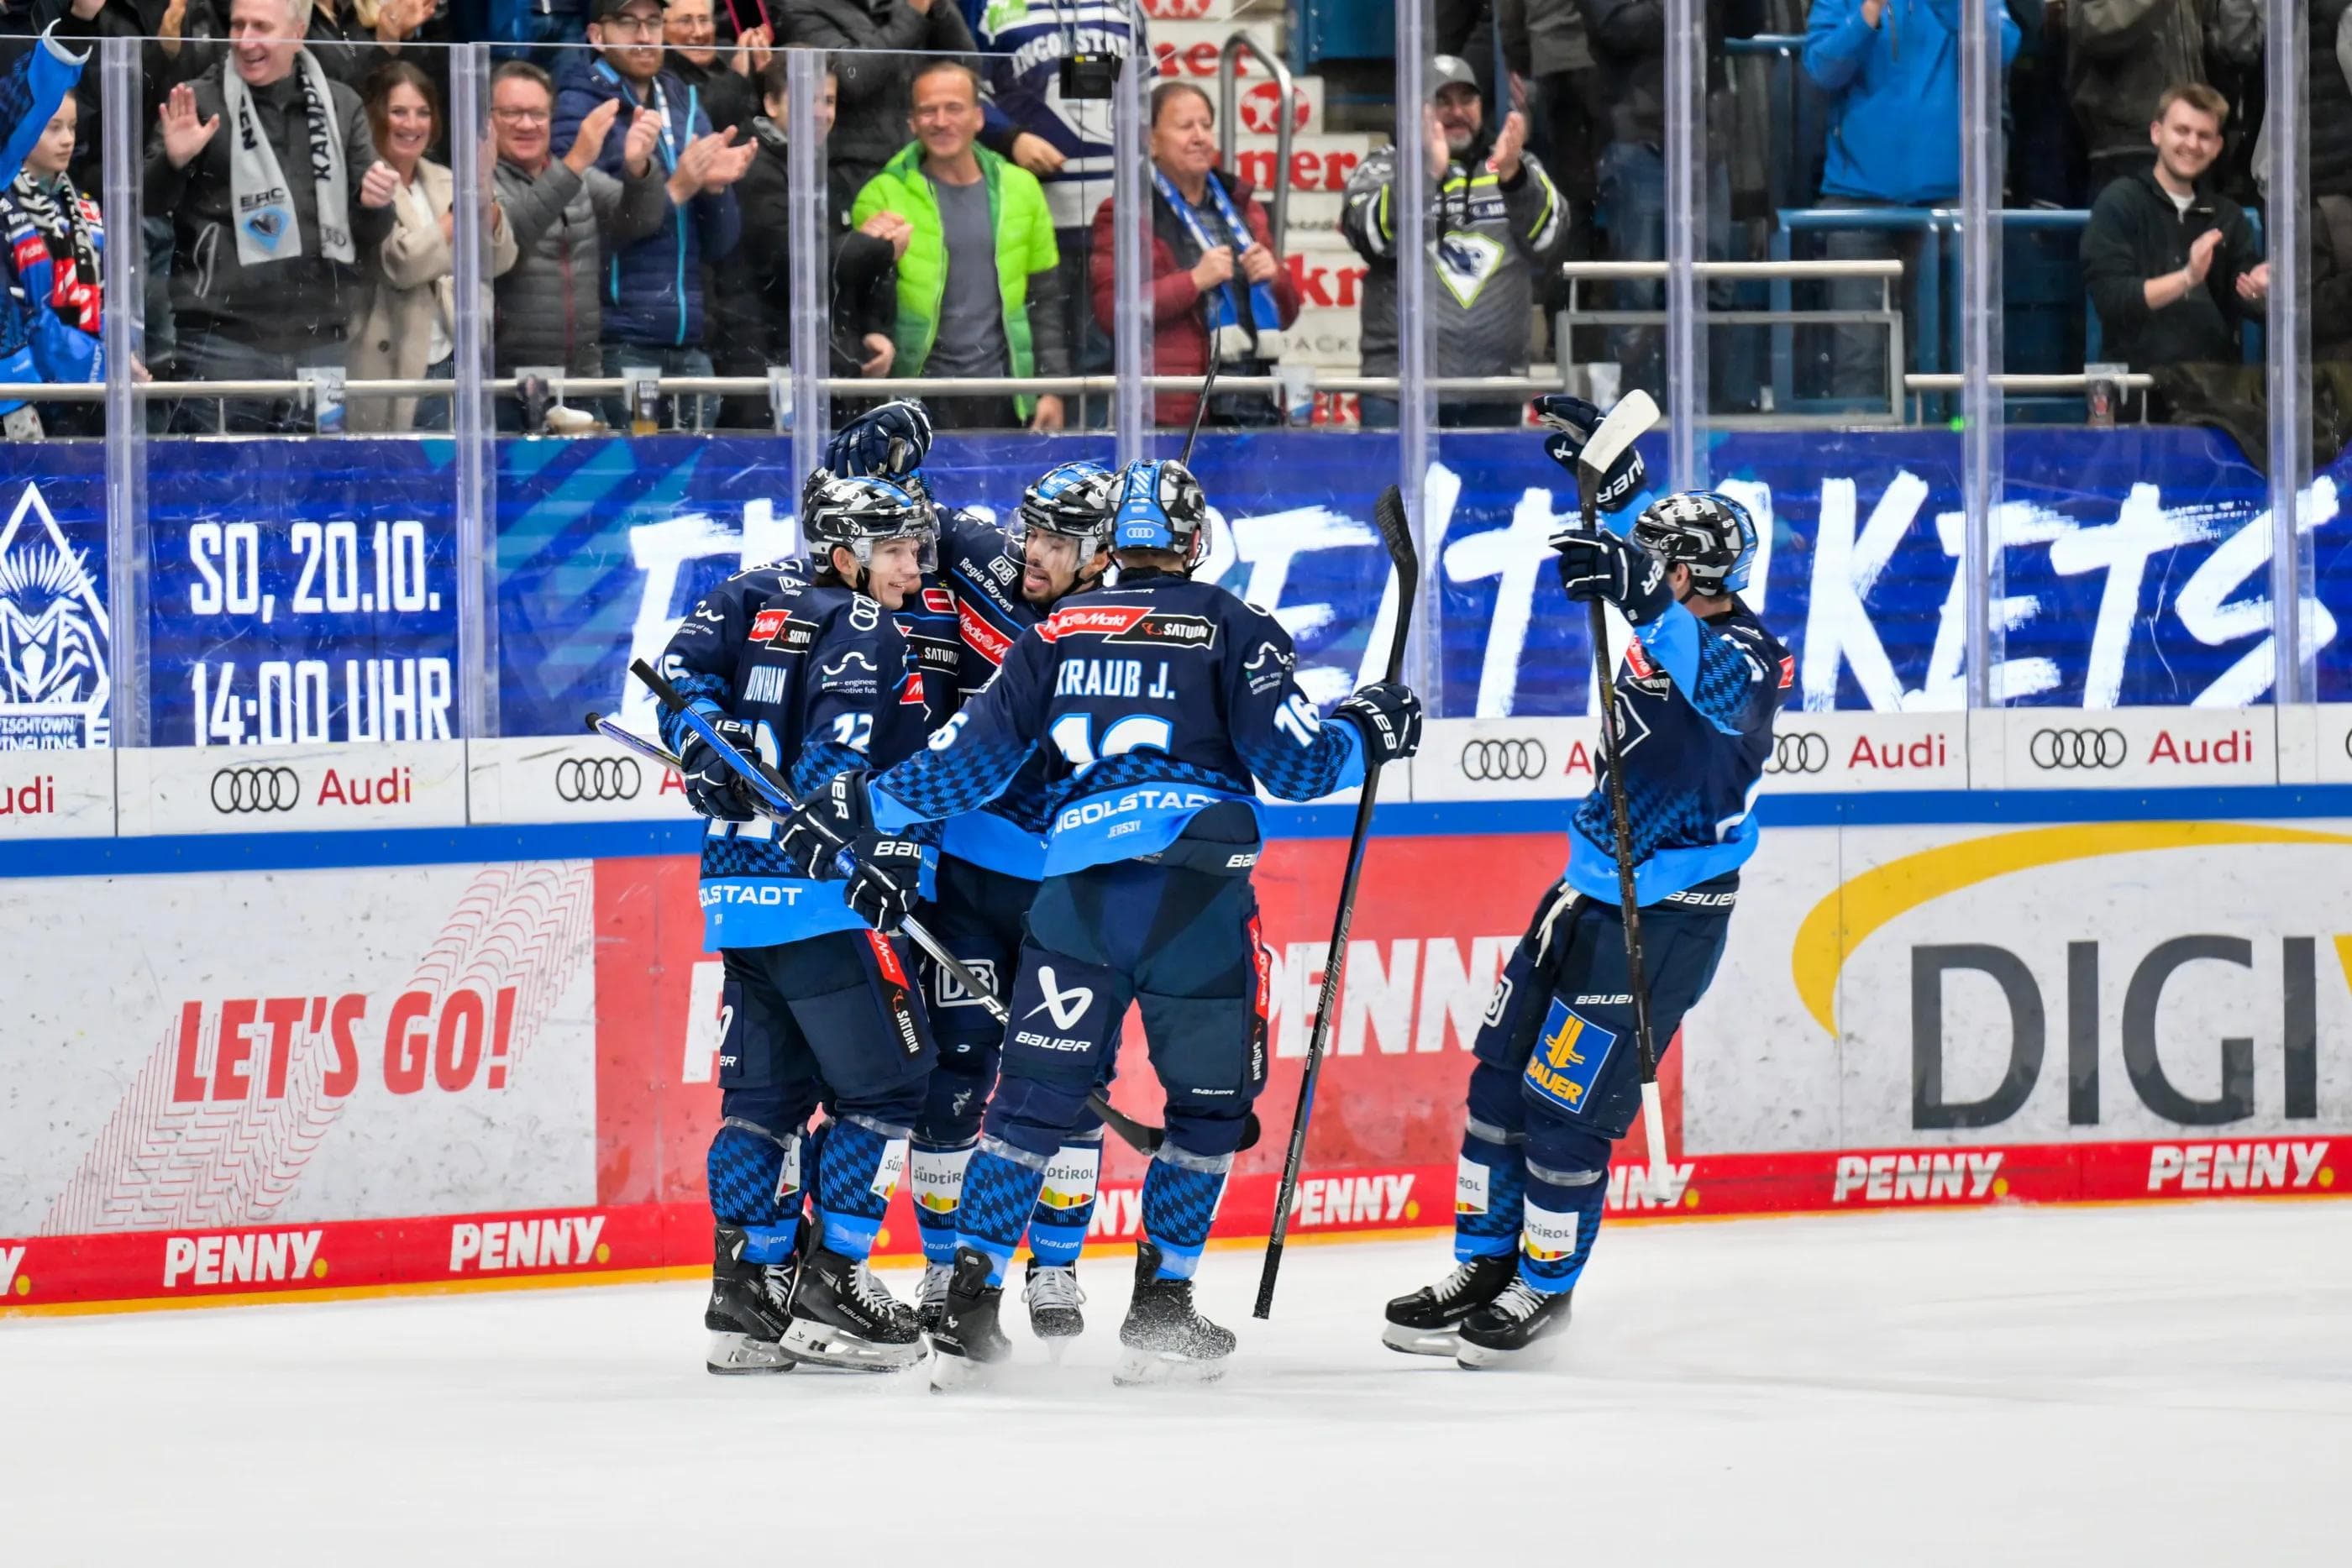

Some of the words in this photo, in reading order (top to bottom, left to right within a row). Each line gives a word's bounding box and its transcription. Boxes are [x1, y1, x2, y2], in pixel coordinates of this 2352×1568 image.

[189, 522, 273, 624] SO,
[290, 520, 441, 613] 20.10.
[959, 557, 984, 583] Regio
[983, 578, 1015, 613] Bayern
[1148, 661, 1176, 700] J.
[192, 660, 332, 747] 14:00
[345, 658, 452, 741] UHR
[0, 716, 76, 734] ISCHTOWN
[1848, 733, 1946, 769] Audi
[2147, 728, 2253, 765] Audi
[0, 775, 54, 815] udi
[318, 767, 412, 806] Audi
[1575, 994, 1634, 1005] BAUE
[172, 994, 367, 1104] LET'S
[382, 987, 517, 1096] GO!
[896, 1009, 921, 1054] SATURN
[1015, 1030, 1092, 1052] BAUER
[1910, 932, 2352, 1130] DIGI
[1191, 1088, 1235, 1097] BAUER
[1526, 1056, 1584, 1105] BAUER
[1040, 1239, 1080, 1250] BAUER
[759, 1309, 785, 1332] BAUER
[837, 1303, 874, 1329] BAUER
